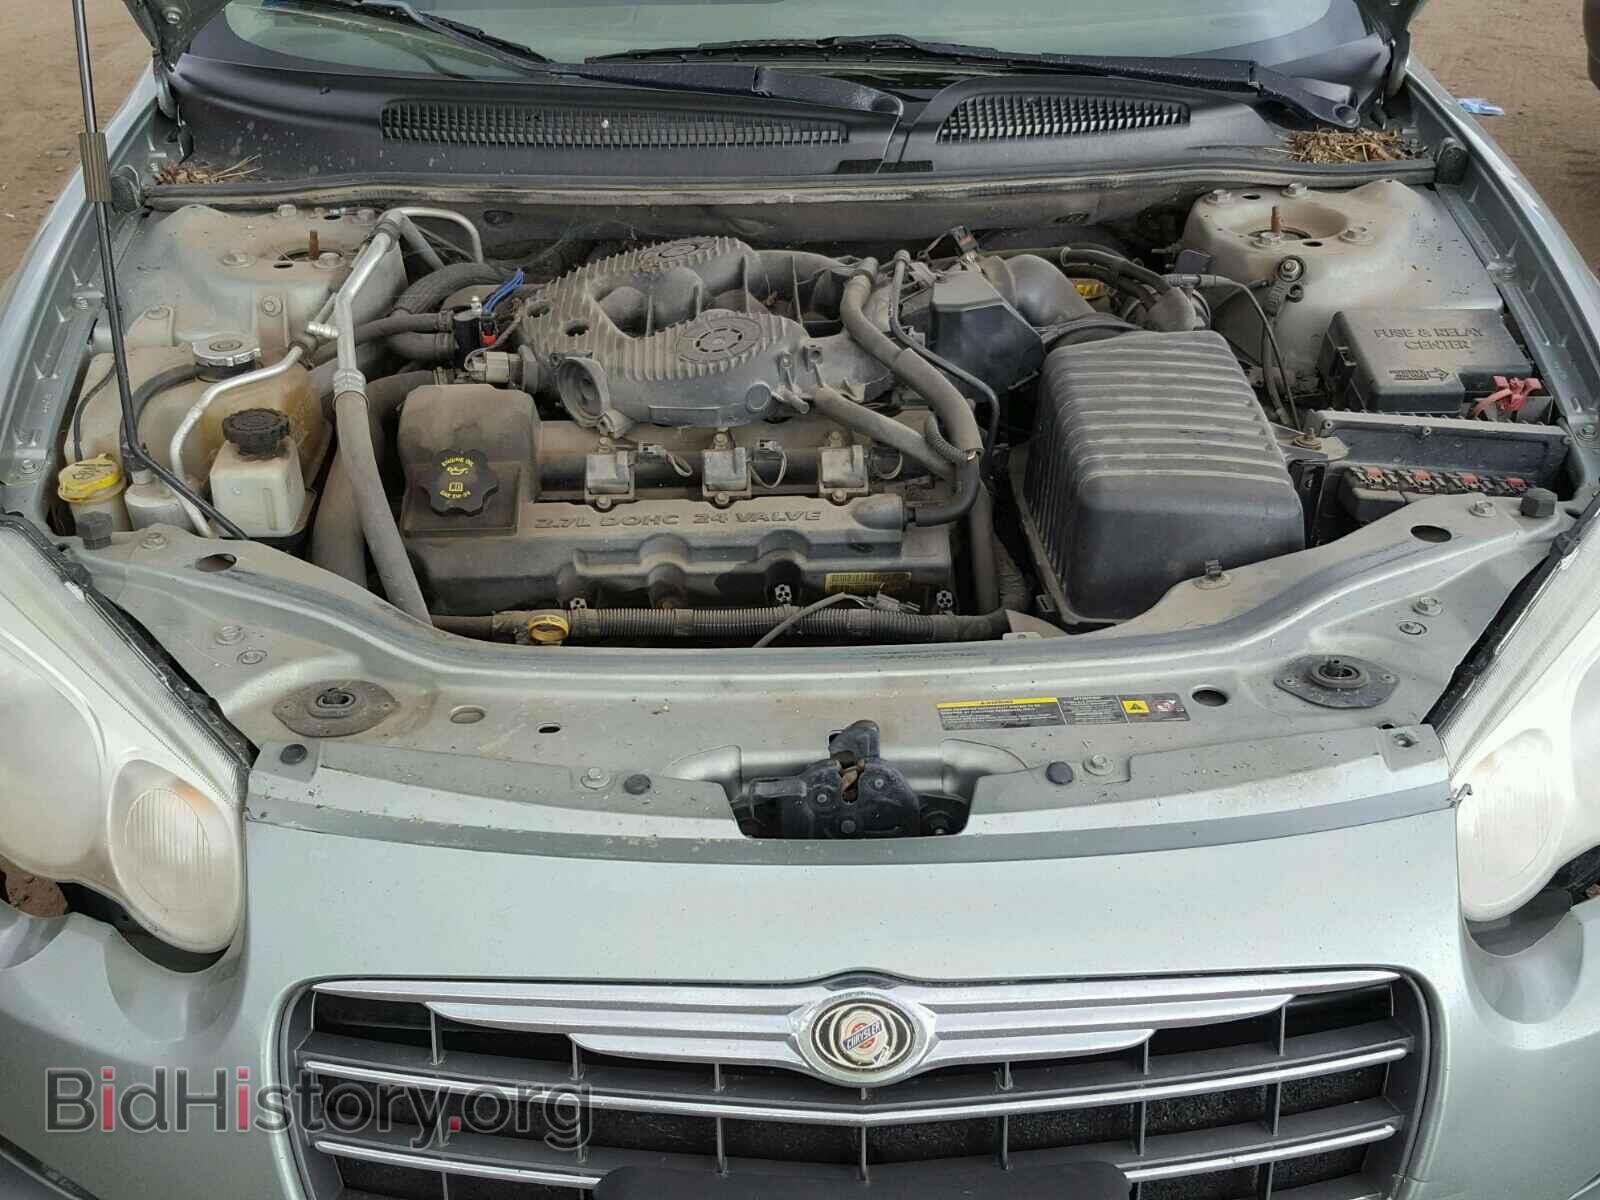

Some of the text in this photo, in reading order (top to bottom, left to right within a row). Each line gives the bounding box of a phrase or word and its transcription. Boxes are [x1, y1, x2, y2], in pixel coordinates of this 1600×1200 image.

[1373, 327, 1484, 338] FUSE & RELAY
[1404, 340, 1471, 350] CENTER
[599, 514, 680, 527] DOHC
[692, 512, 729, 524] 24
[735, 511, 822, 523] VALVE
[846, 1020, 882, 1050] CHRYSLER
